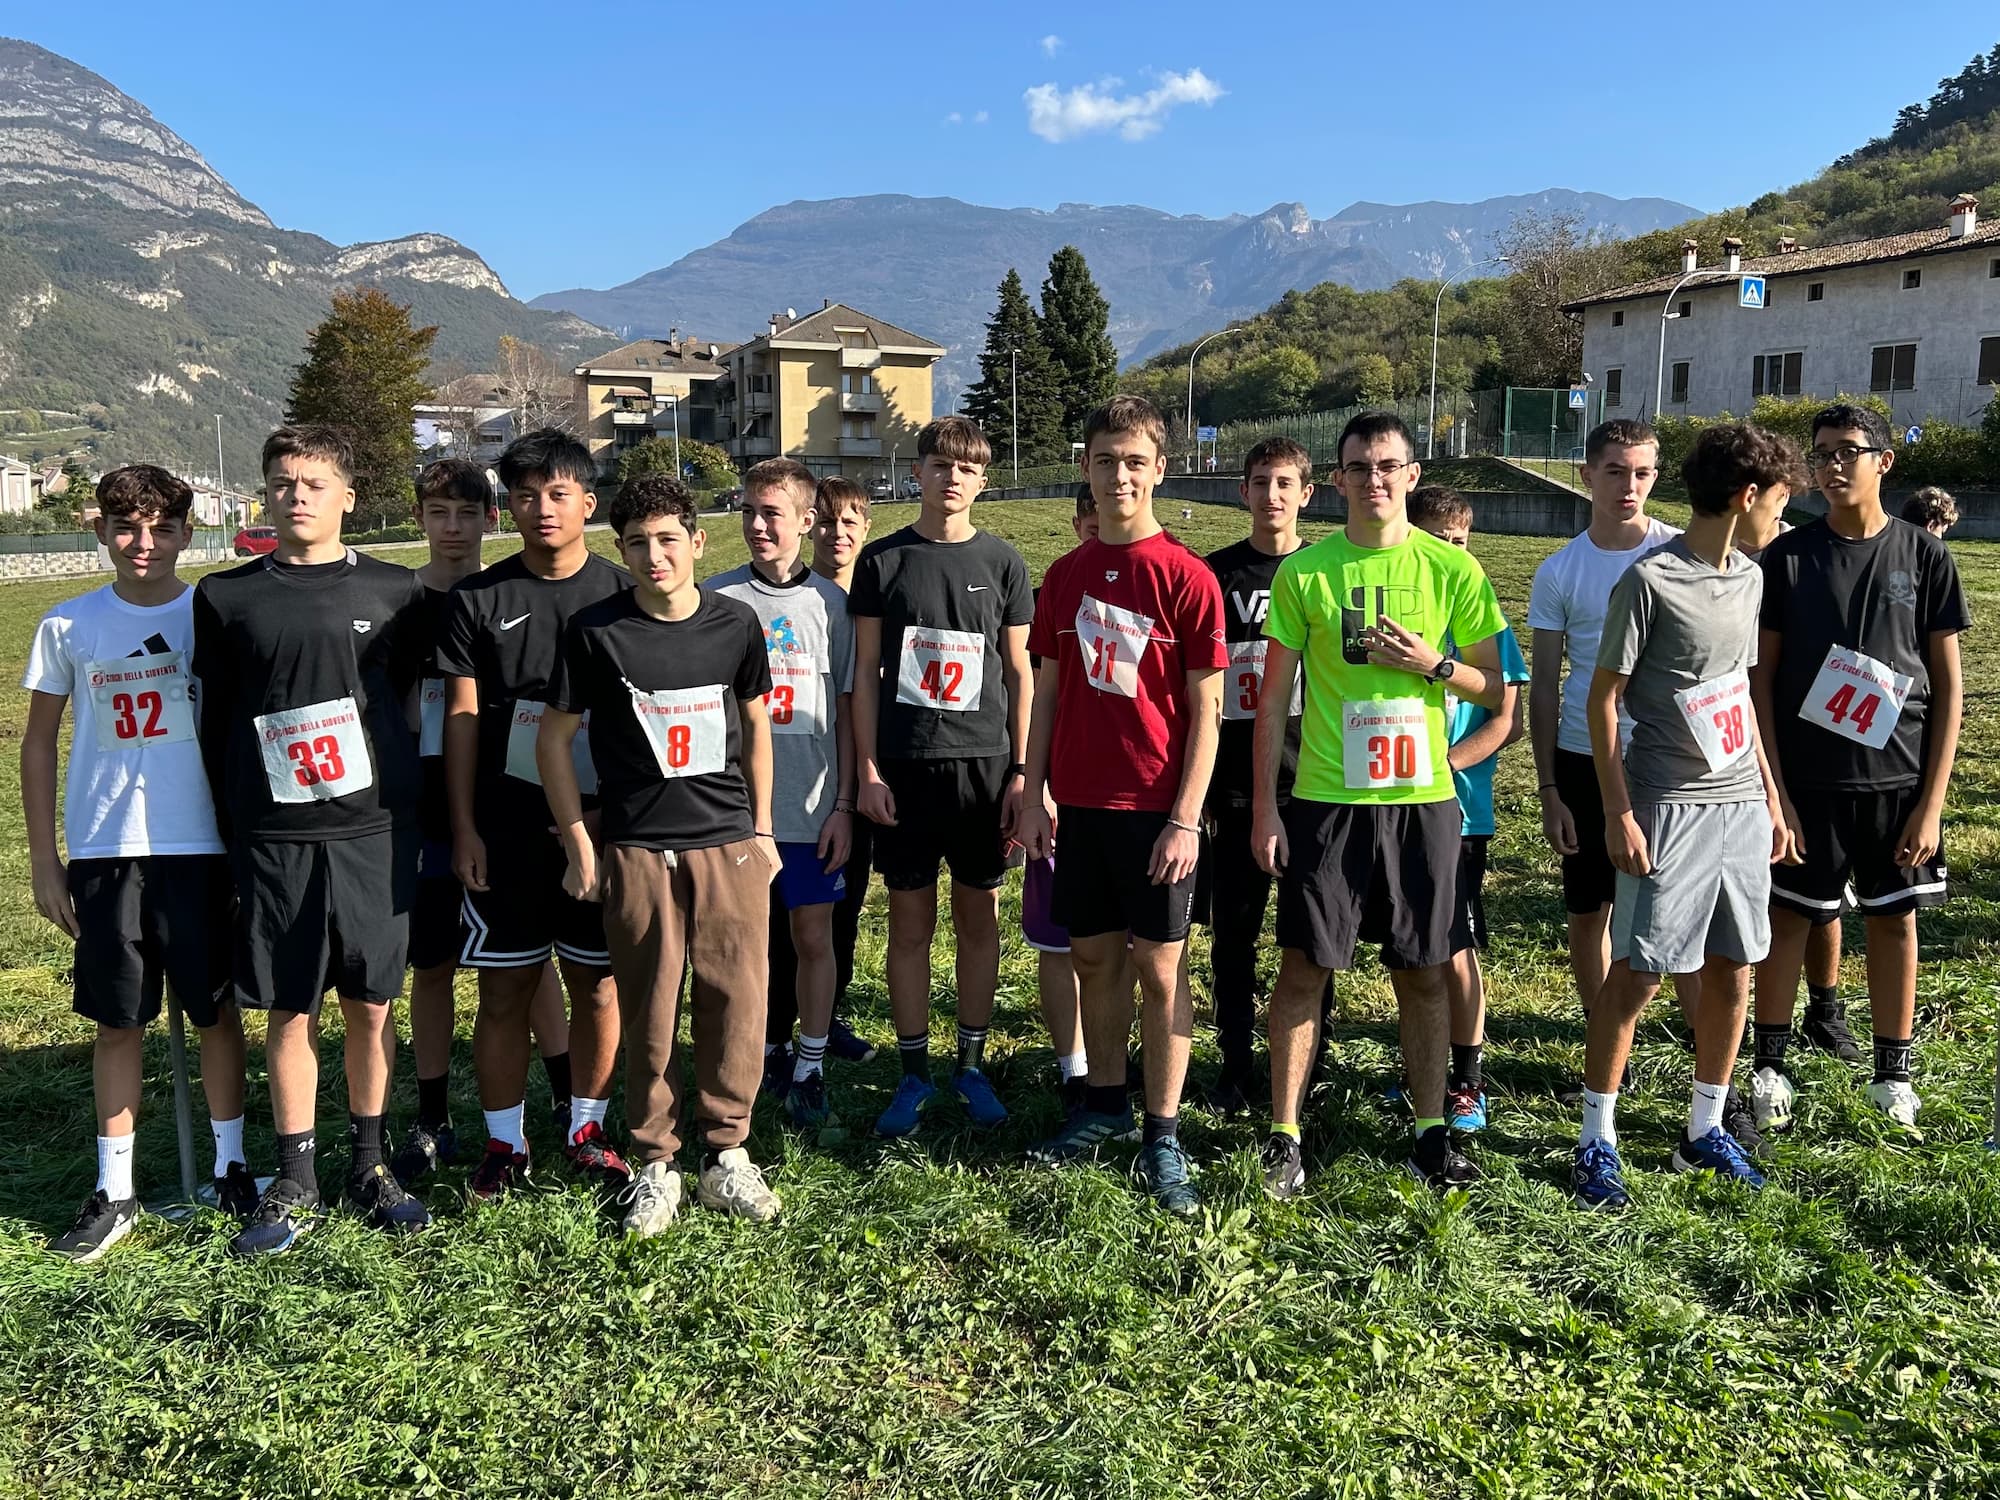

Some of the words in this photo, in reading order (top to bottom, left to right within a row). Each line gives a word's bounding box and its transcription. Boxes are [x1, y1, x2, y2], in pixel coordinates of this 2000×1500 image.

[1231, 589, 1271, 623] VA
[123, 670, 143, 681] DELLA
[920, 660, 964, 702] 42
[1237, 672, 1258, 711] 3
[112, 690, 169, 739] 32
[673, 704, 692, 714] DELLA
[762, 684, 795, 725] 3
[1824, 682, 1882, 735] 44
[667, 724, 691, 768] 8
[1713, 704, 1744, 755] 38
[287, 734, 346, 787] 33
[1367, 734, 1417, 780] 30
